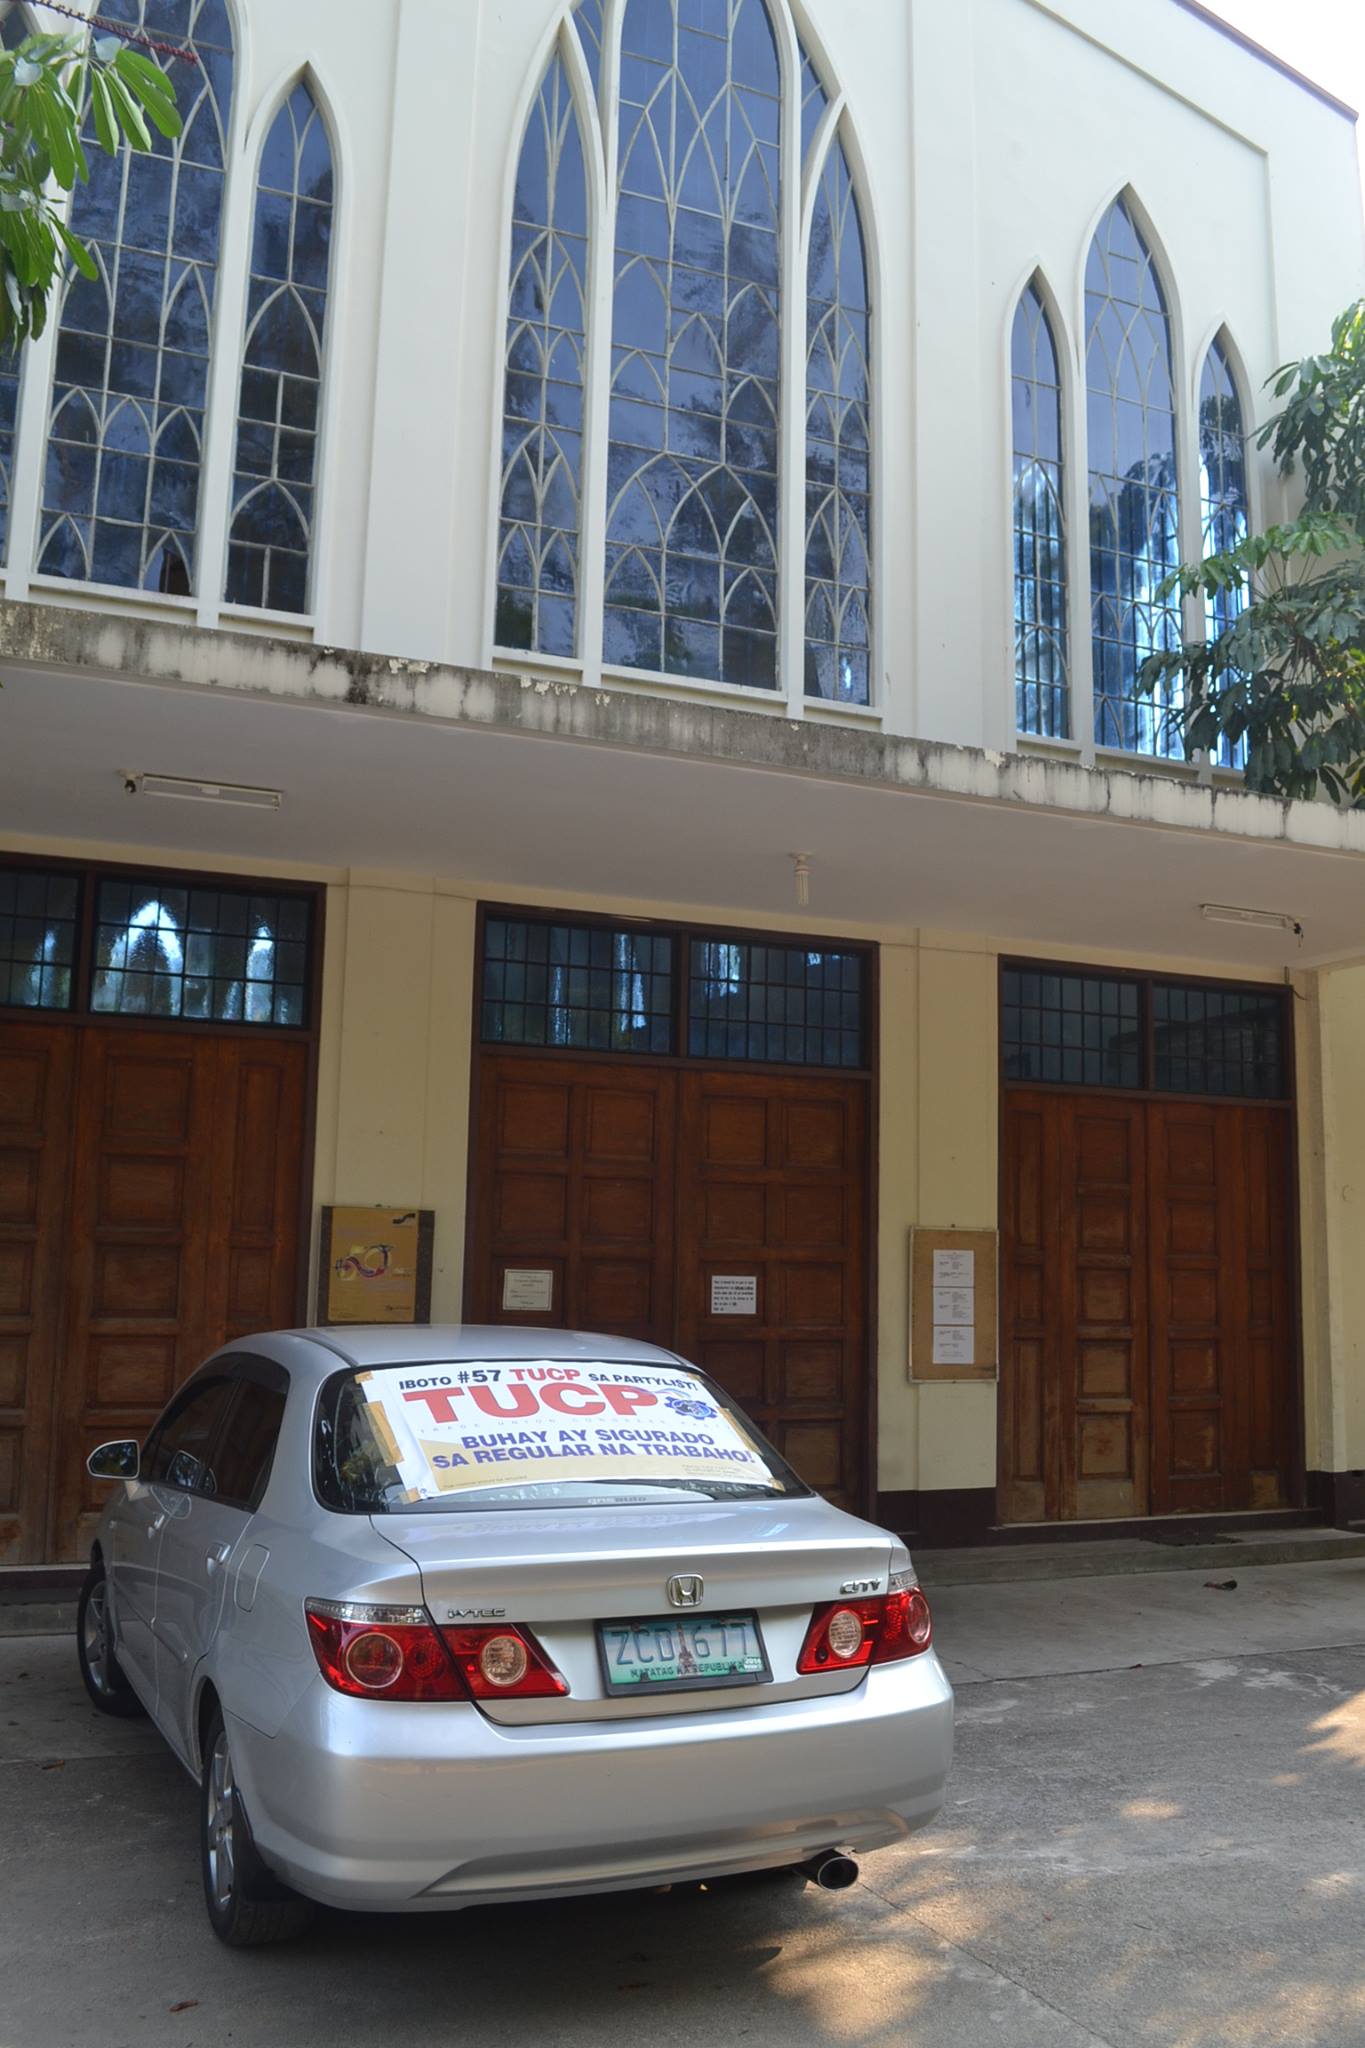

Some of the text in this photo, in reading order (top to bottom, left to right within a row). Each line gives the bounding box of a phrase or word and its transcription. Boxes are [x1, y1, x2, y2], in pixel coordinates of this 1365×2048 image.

[399, 1368, 698, 1391] IBOTO #57 TUCP SA PARTYLIST!
[402, 1382, 658, 1423] TUCP
[461, 1429, 715, 1449] BUHAY AY SIGURADO
[432, 1443, 756, 1469] SA REGULAR NA TRABAHO!
[611, 1622, 748, 1665] ZCD 677
